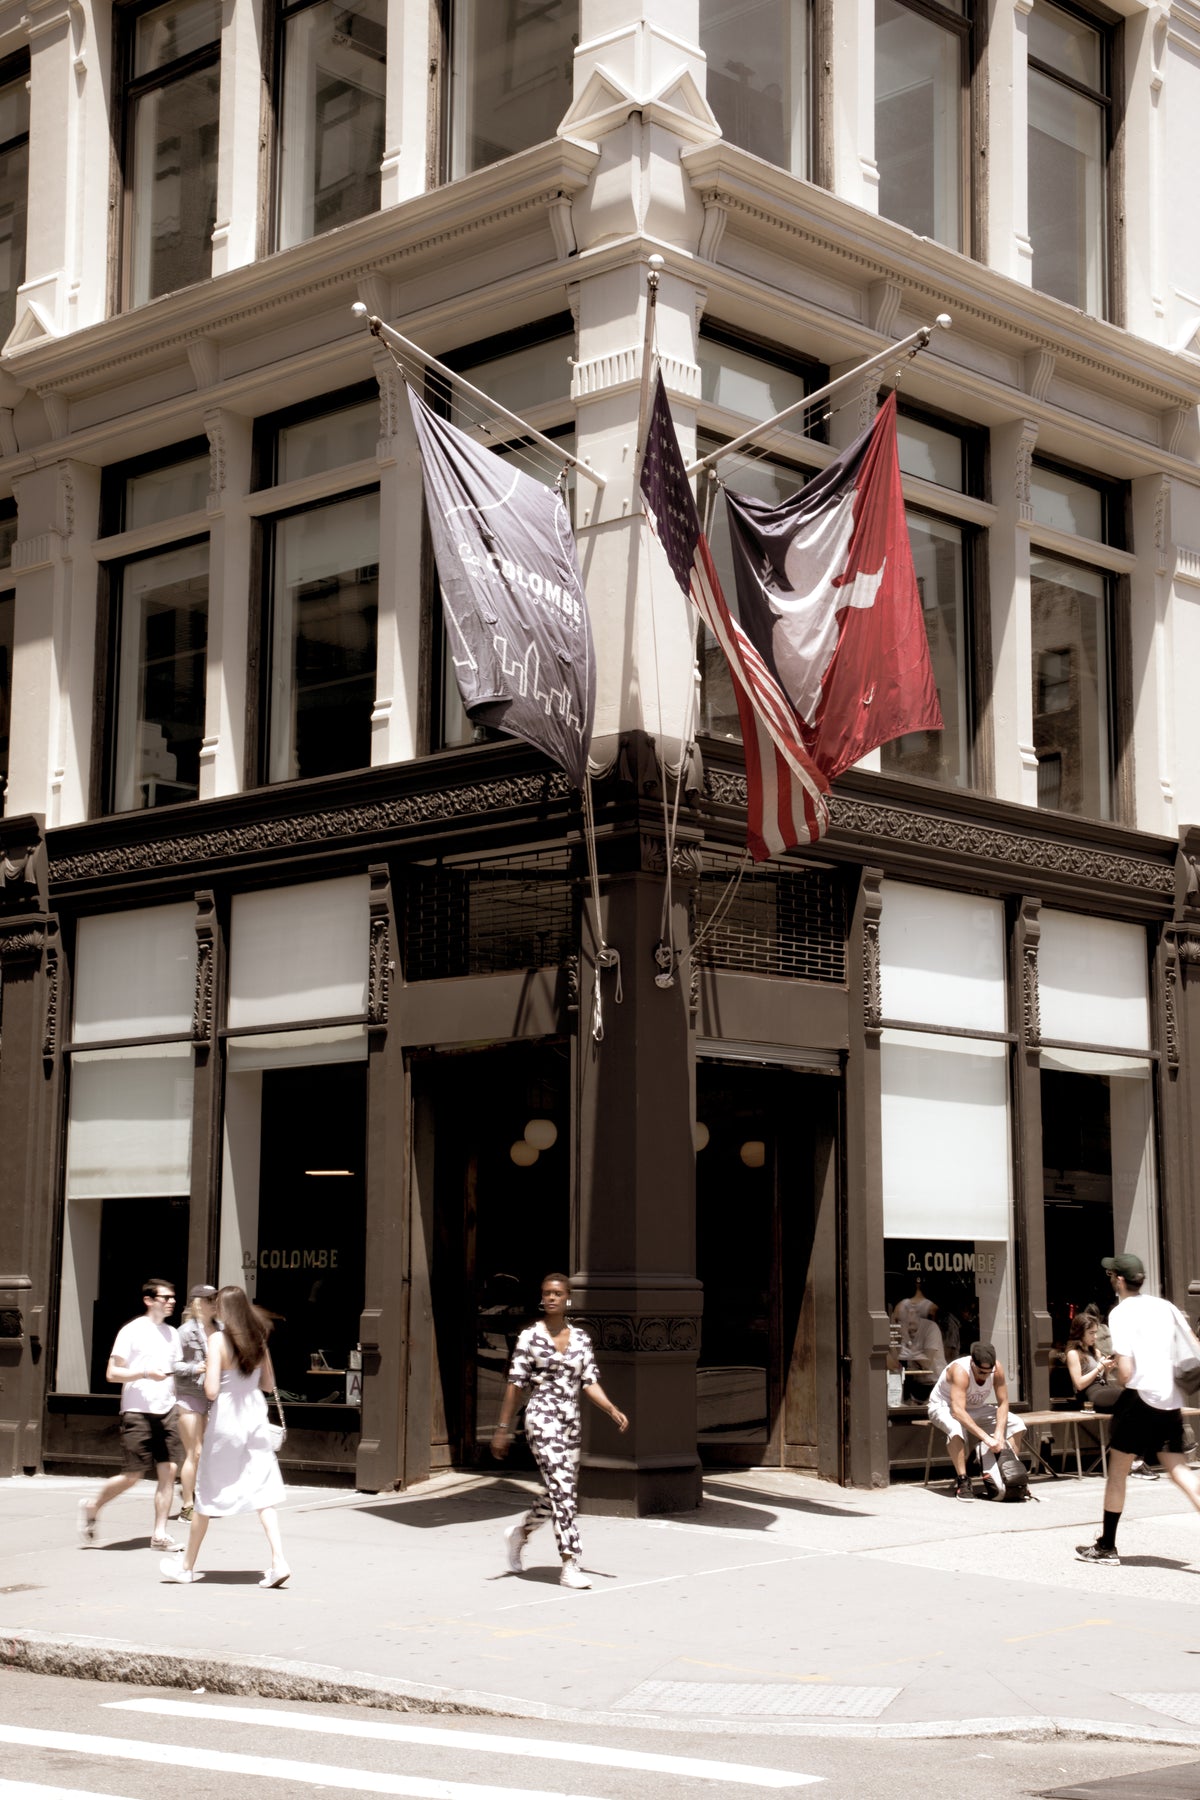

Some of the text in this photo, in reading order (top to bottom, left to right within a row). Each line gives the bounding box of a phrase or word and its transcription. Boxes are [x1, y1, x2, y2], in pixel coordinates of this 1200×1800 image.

[486, 553, 582, 625] COLOMBE
[242, 1249, 339, 1269] La COLOMBE
[906, 1252, 996, 1273] La COLOMBE
[349, 1374, 362, 1396] A
